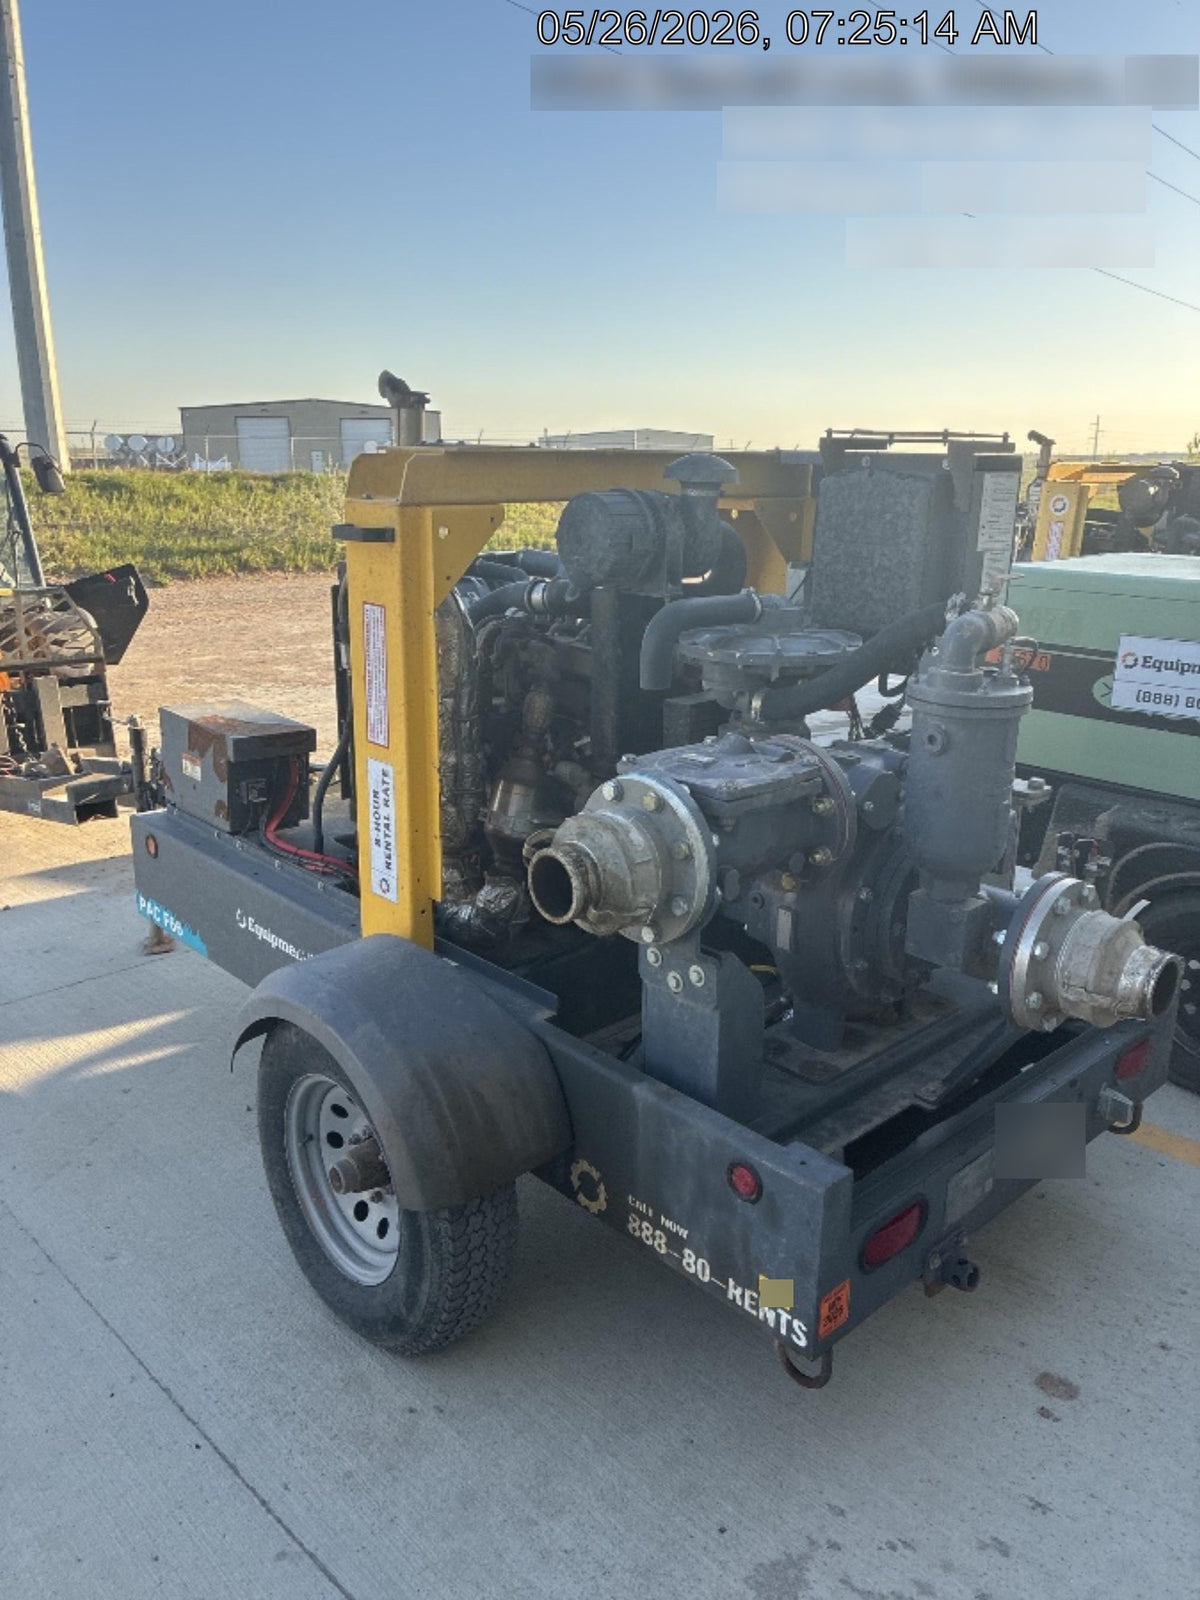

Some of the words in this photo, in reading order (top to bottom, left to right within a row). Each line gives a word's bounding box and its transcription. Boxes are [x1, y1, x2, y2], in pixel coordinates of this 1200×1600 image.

[1135, 689, 1180, 709] (888)
[382, 768, 392, 808] RATE
[383, 815, 393, 871] RENTAL
